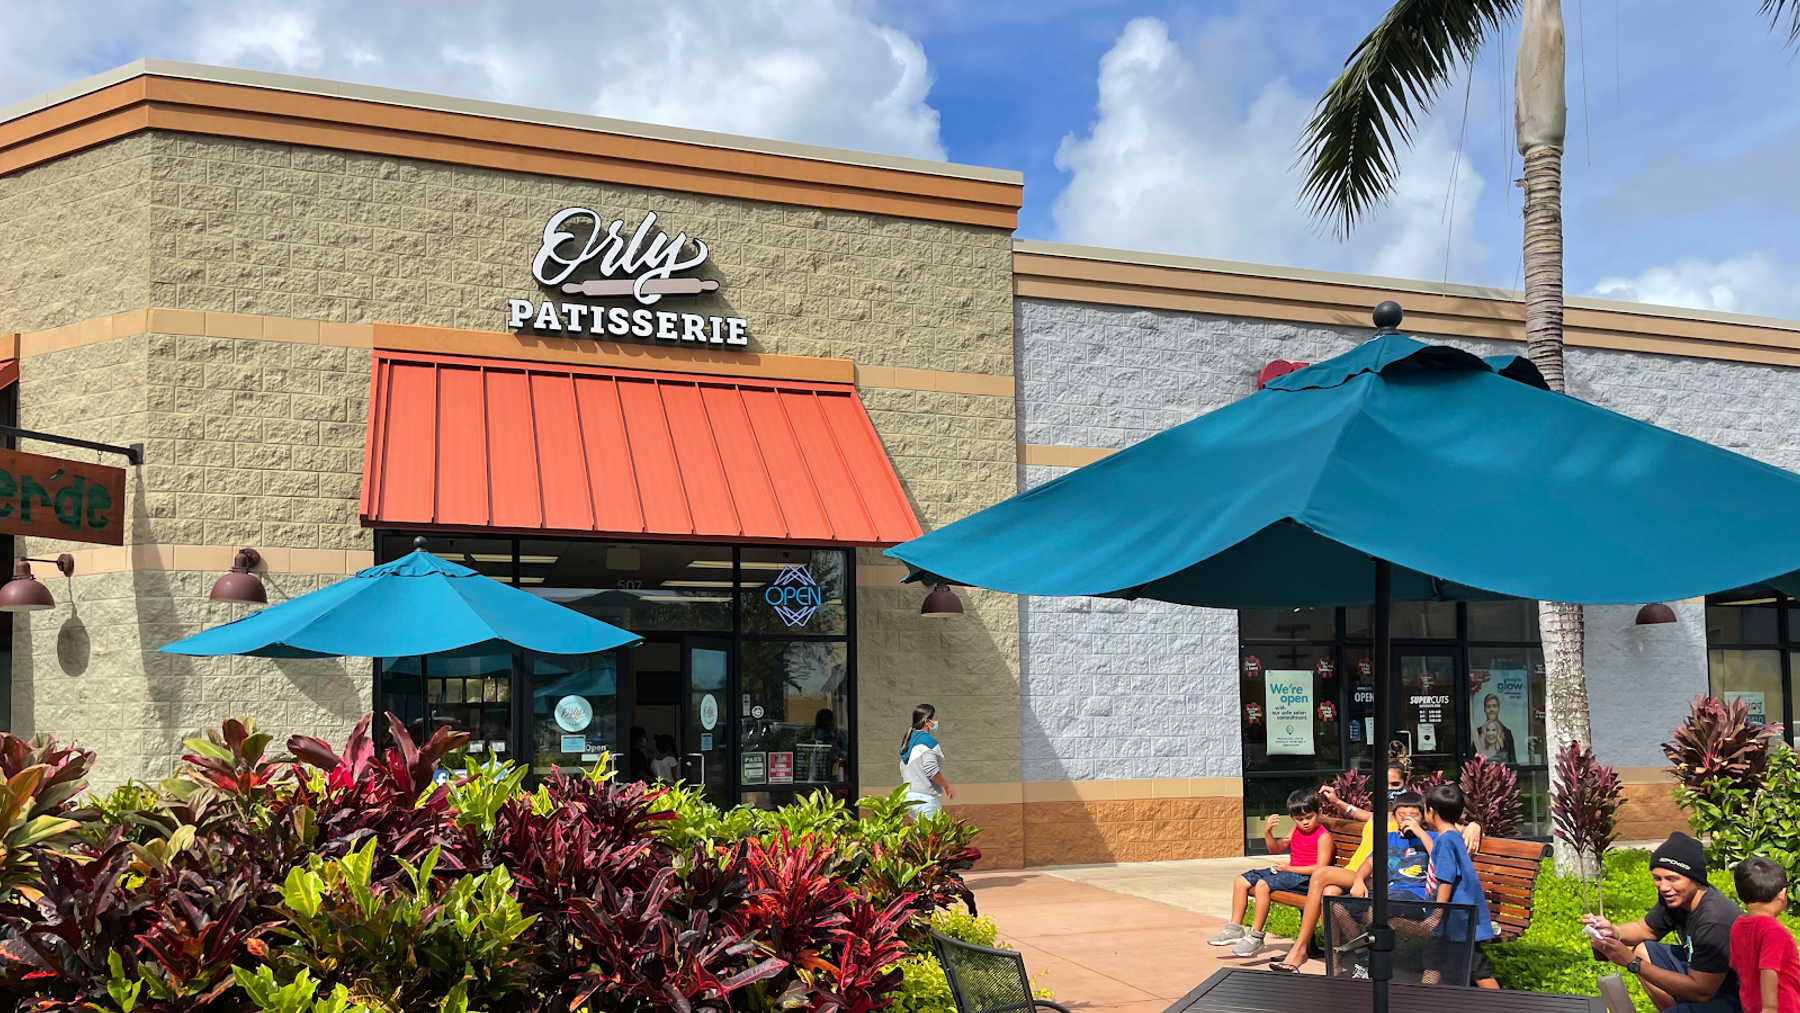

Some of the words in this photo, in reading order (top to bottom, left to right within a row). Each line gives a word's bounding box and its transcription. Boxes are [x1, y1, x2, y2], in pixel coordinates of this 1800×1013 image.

[531, 206, 709, 305] Orly
[508, 298, 749, 346] PATISSERIE
[617, 579, 642, 590] 507
[765, 586, 821, 606] OPEN
[1270, 683, 1303, 694] We're
[1497, 679, 1523, 693] glow
[1280, 695, 1308, 706] open
[1409, 695, 1450, 704] SUPERCUTS
[586, 744, 607, 753] Open
